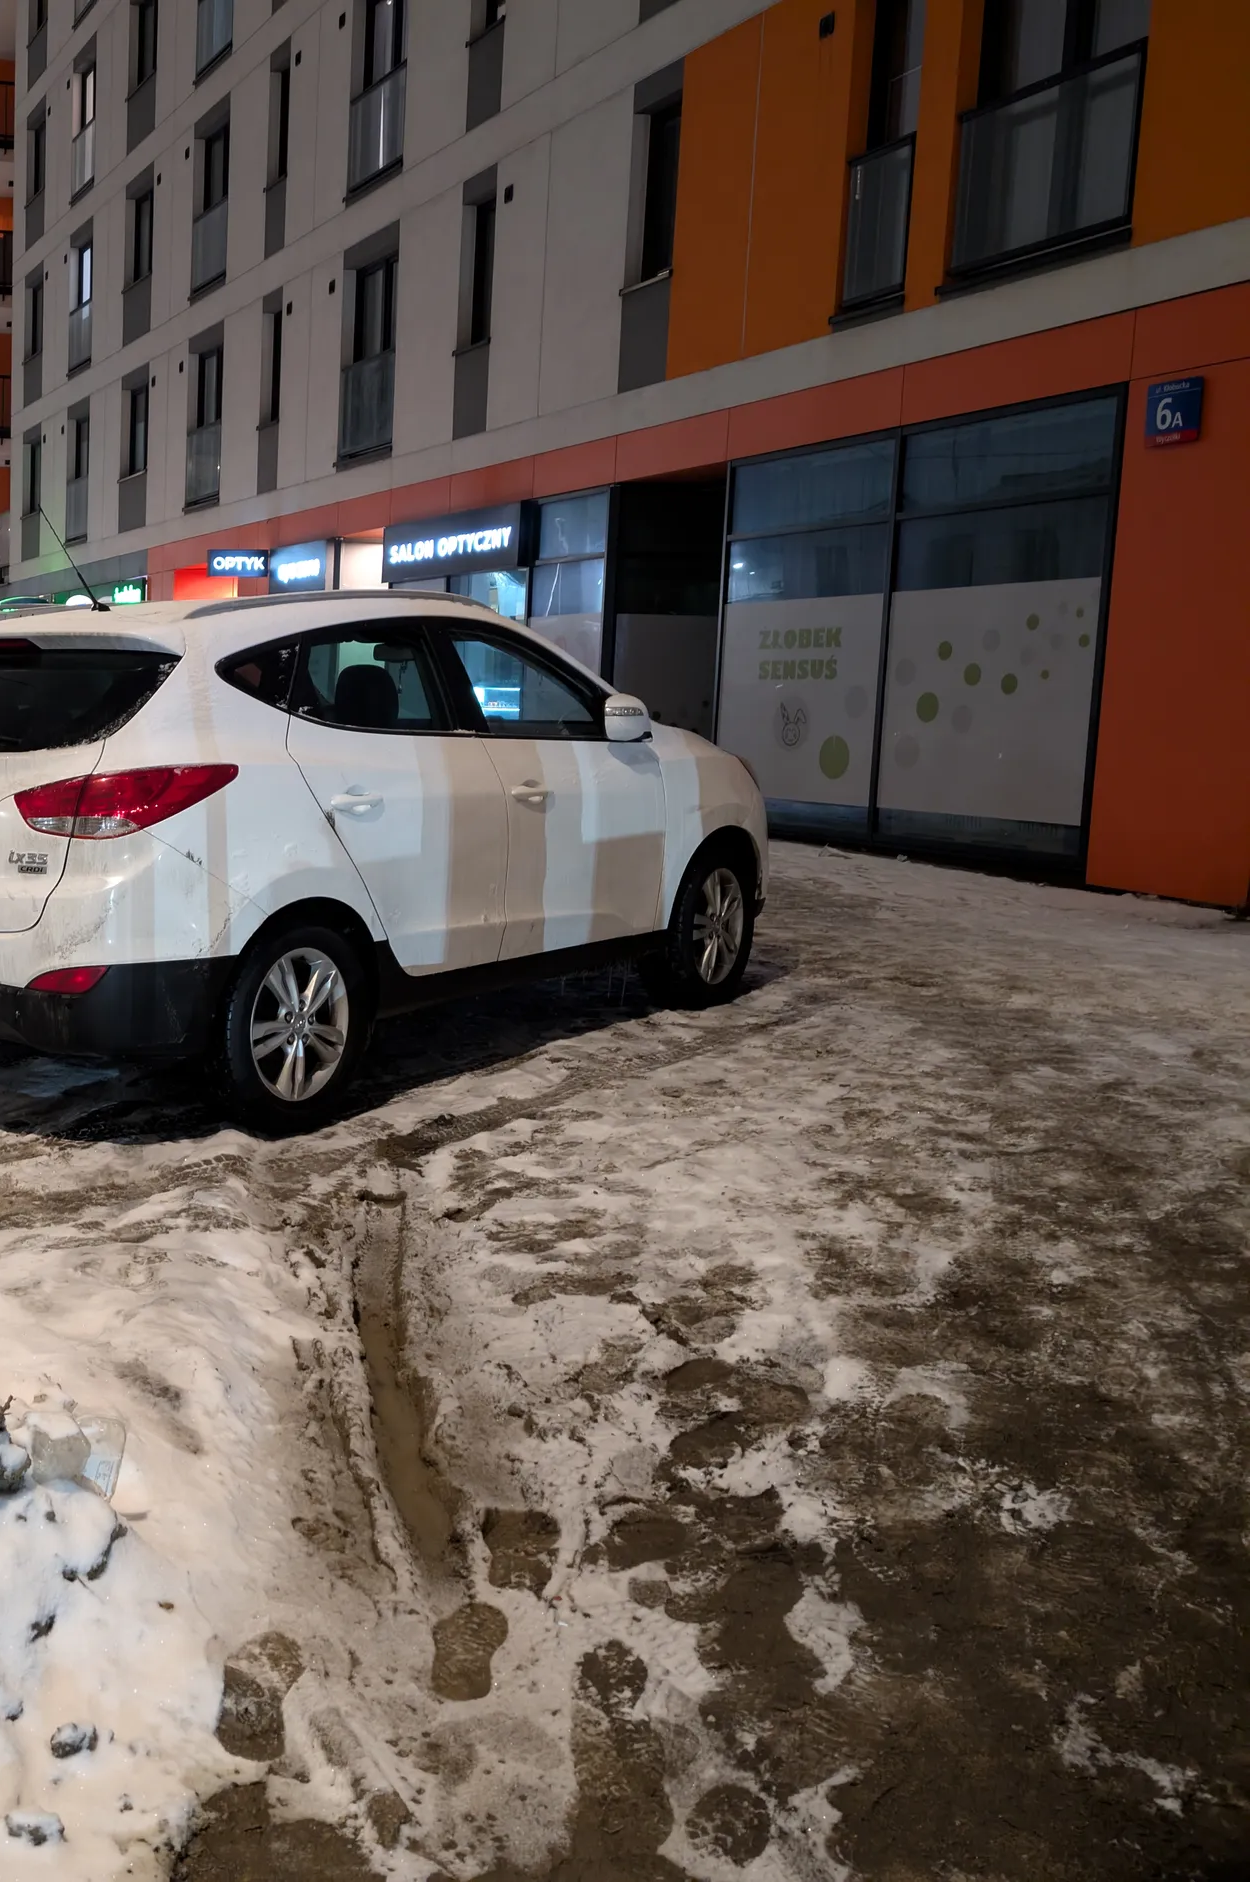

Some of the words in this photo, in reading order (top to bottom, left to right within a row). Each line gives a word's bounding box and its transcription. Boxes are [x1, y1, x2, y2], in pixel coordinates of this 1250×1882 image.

[389, 539, 435, 564] SALON
[437, 526, 511, 558] OPTYCZNY
[213, 556, 265, 571] OPTYK
[758, 626, 843, 650] ŻŁOBEK
[758, 655, 838, 680] SENSUŚ
